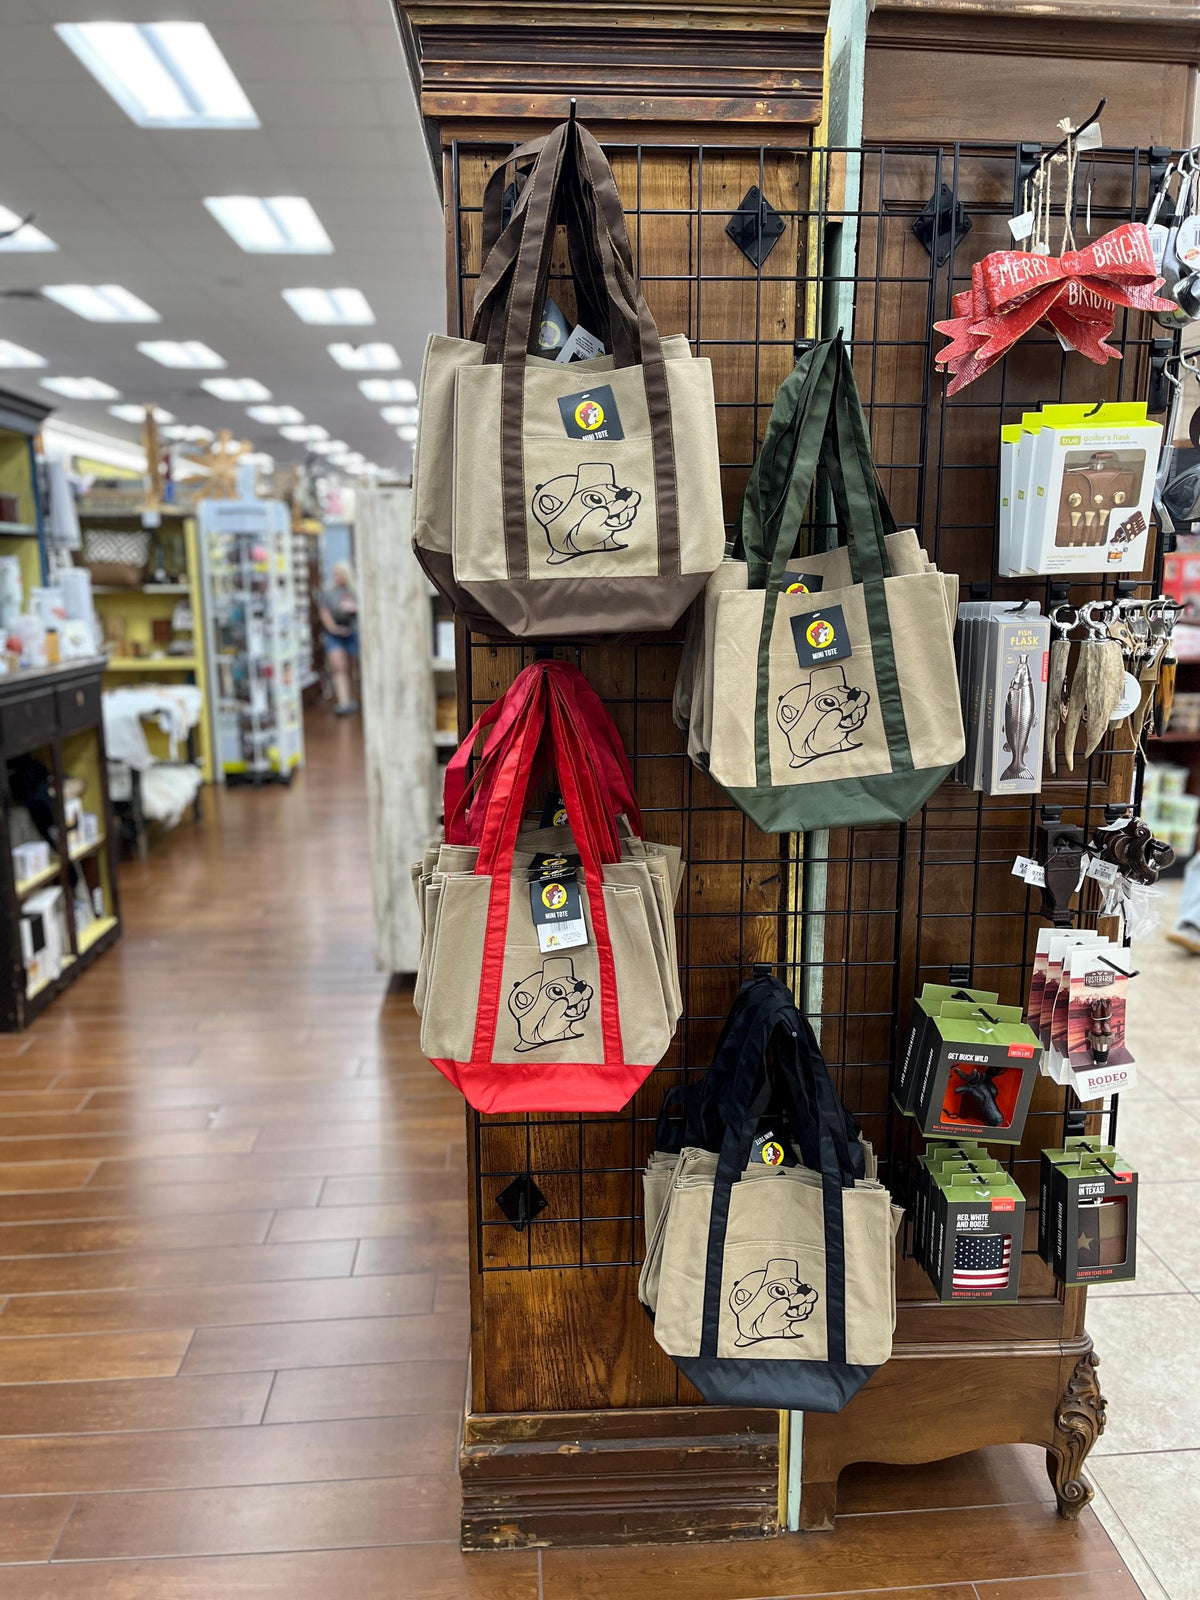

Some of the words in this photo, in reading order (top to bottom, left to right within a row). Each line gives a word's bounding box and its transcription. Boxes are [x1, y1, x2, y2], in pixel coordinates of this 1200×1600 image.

[999, 257, 1049, 287] MERRY
[1093, 231, 1150, 268] BRIGHT
[594, 430, 609, 440] TOTE
[1083, 434, 1111, 442] golfer's
[1113, 433, 1130, 441] flask
[1017, 629, 1033, 637] FISH
[1010, 636, 1039, 646] FLASK
[811, 651, 825, 660] MINI
[824, 647, 838, 657] TOTE
[545, 912, 557, 920] MINI
[556, 910, 569, 918] TOTE
[947, 1052, 959, 1060] GET
[958, 1053, 974, 1062] BUCK
[974, 1055, 989, 1063] WILD
[1087, 1071, 1128, 1087] RODEO
[1078, 1187, 1085, 1196] IN
[956, 1213, 970, 1221] RED,
[970, 1213, 989, 1221] WHITE
[956, 1220, 969, 1228] AND
[969, 1220, 990, 1228] BOOZE.
